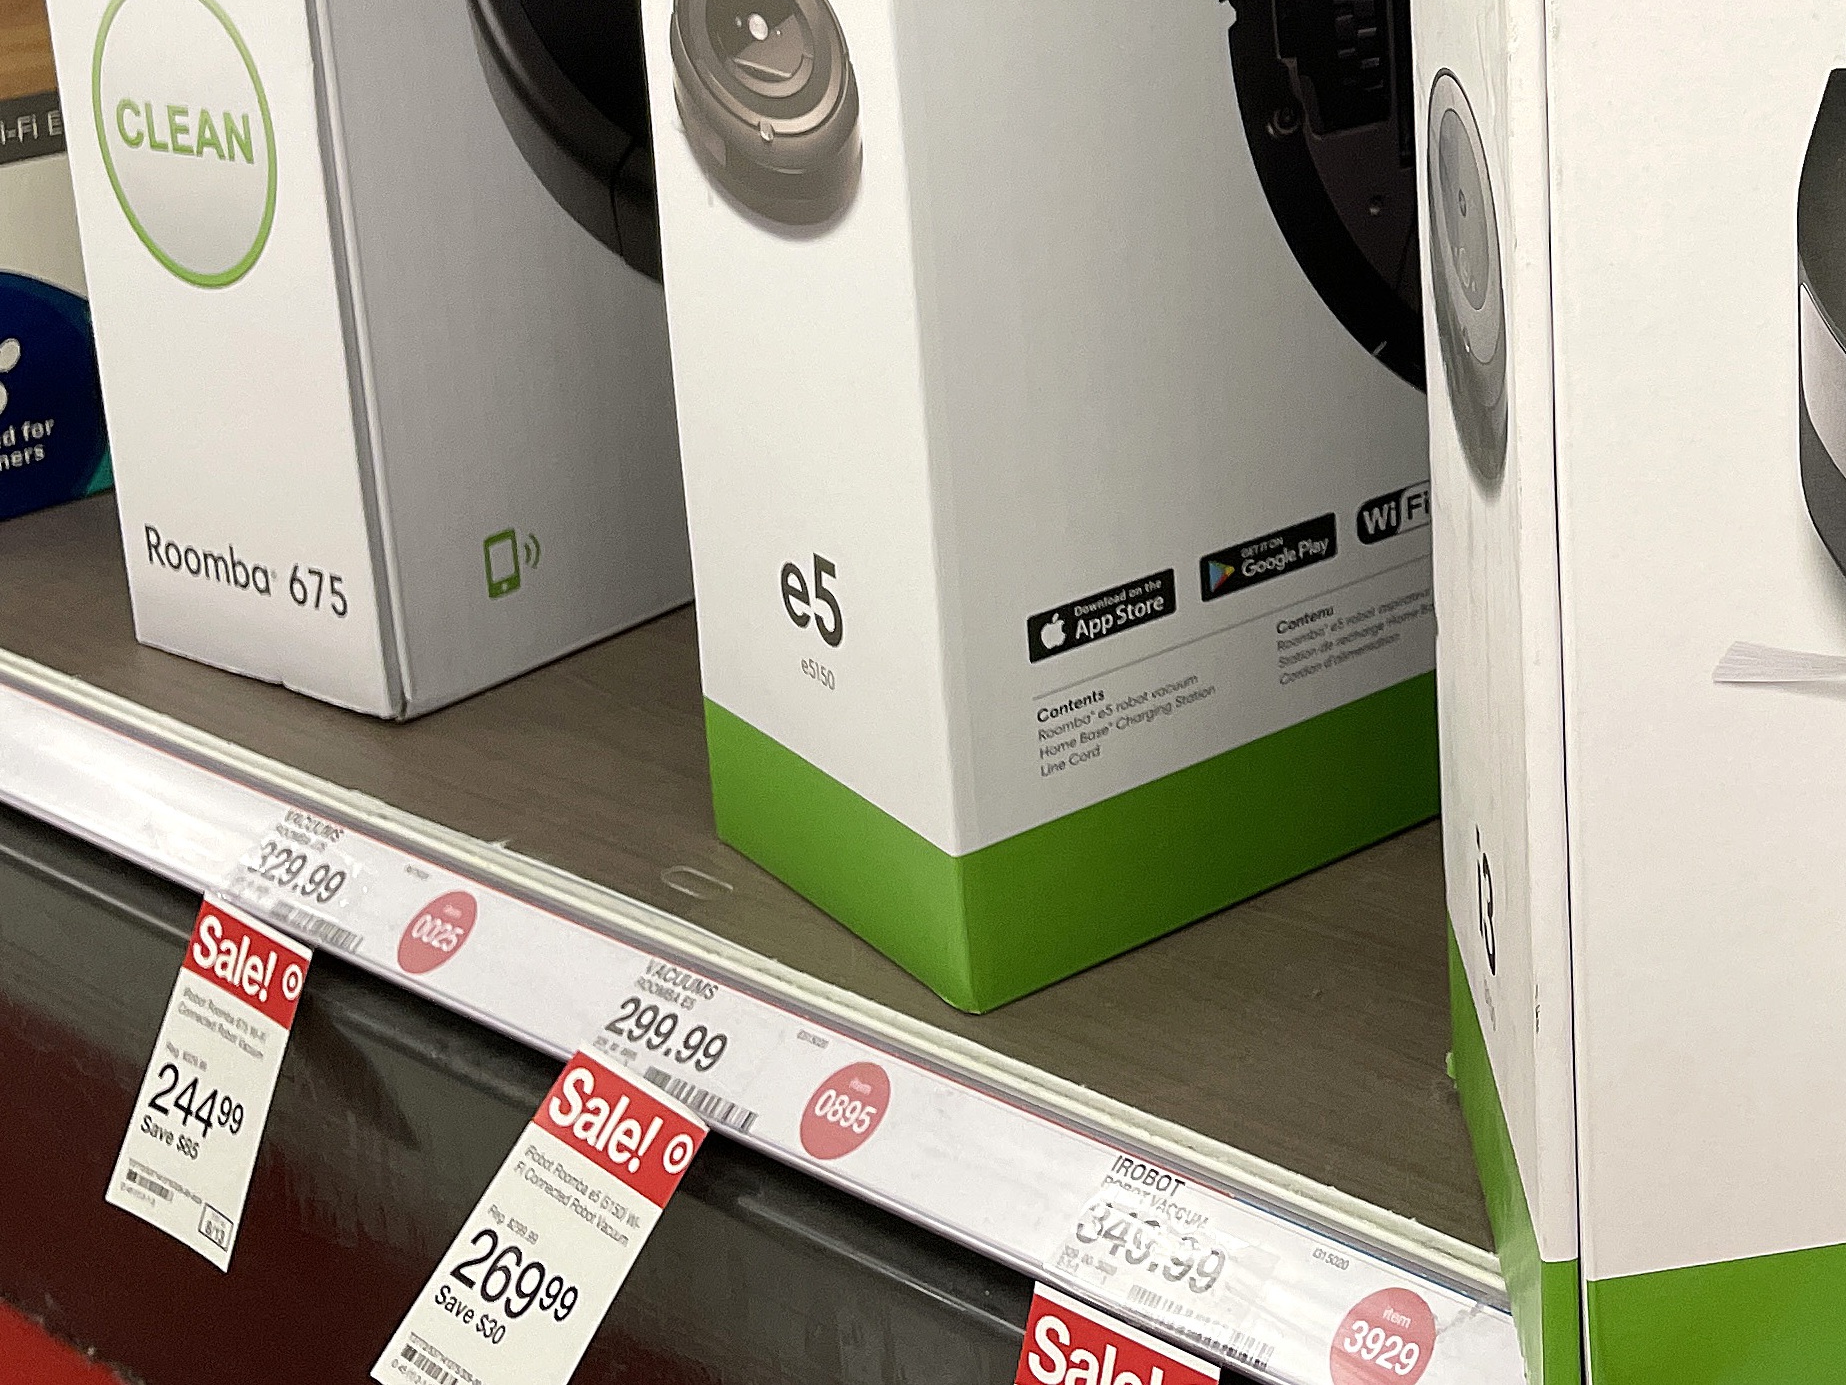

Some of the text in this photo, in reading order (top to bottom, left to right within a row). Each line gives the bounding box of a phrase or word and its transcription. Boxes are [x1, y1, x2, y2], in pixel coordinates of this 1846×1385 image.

[116, 98, 254, 165] CLEAN
[22, 419, 54, 442] for
[144, 524, 349, 619] Roomba 675
[1241, 538, 1330, 577] Google Play
[781, 552, 843, 648] e5
[1074, 579, 1162, 617] Download on the
[1075, 596, 1164, 640] App Store
[1276, 606, 1335, 634] Contenu
[801, 658, 835, 691] e5150
[1037, 690, 1105, 723] Contents
[1039, 738, 1077, 760] Home
[1115, 701, 1172, 730] Charging
[1175, 685, 1216, 708] Station
[1040, 744, 1101, 777] Line Cord
[1475, 823, 1496, 977] i3
[192, 915, 276, 1003] Sale!
[605, 996, 728, 1072] 299.99
[140, 1114, 174, 1146] Save
[548, 1067, 664, 1174] Sale!
[814, 1088, 878, 1134] 0895
[1111, 1155, 1186, 1197] IROBOT
[434, 1285, 506, 1345] Save $30
[1028, 1315, 1164, 1385] Sal
[1343, 1320, 1420, 1375] 3929
